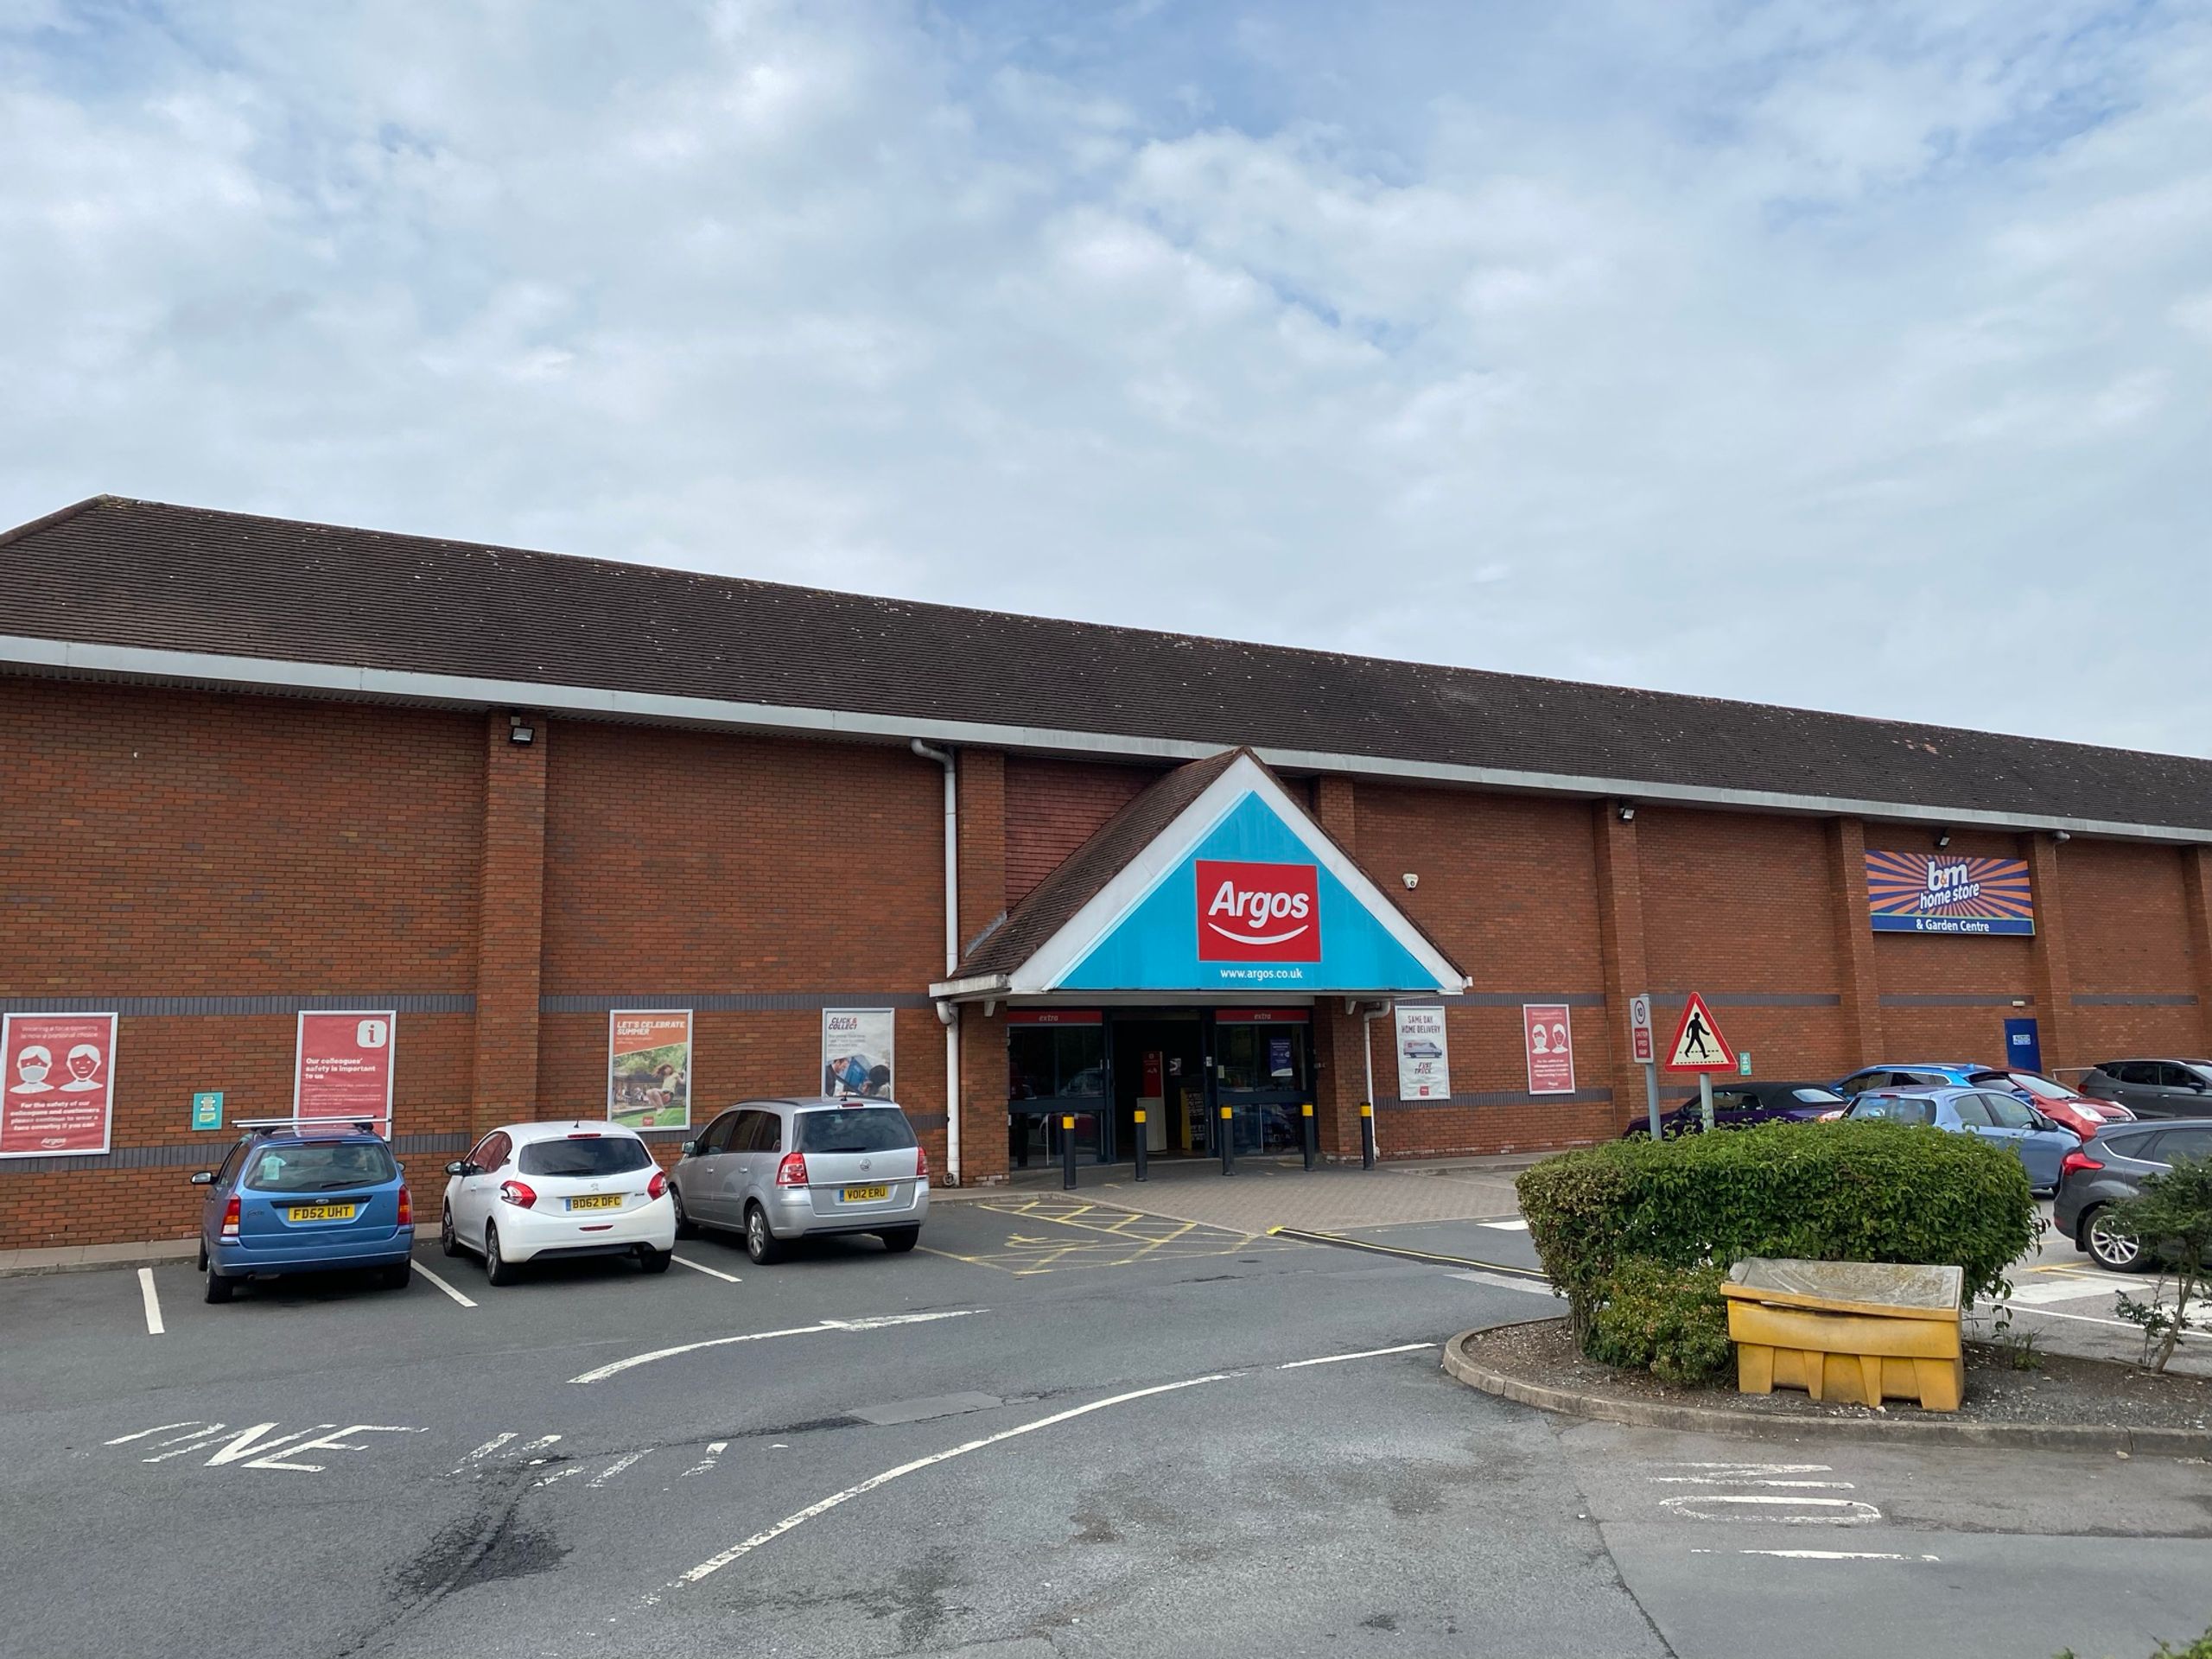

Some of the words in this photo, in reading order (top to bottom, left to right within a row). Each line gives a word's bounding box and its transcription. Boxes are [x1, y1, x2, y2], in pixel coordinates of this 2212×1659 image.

[1920, 890, 1951, 909] home
[1953, 883, 1980, 901] store
[1208, 880, 1309, 928] Argos
[1916, 918, 1923, 930] &
[1925, 919, 1958, 931] Garden
[1960, 920, 1990, 931] Centre
[1220, 968, 1303, 982] www.argos.co.uk
[1408, 1015, 1422, 1024] SAME
[1402, 1025, 1415, 1033] HOME
[1417, 1025, 1440, 1033] DELIVERY
[868, 1188, 886, 1198] ERU
[572, 1198, 600, 1209] BD62
[601, 1197, 620, 1206] DFC
[294, 1208, 324, 1219] FD52
[327, 1206, 350, 1217] UHT
[102, 1421, 429, 1471] ONE
